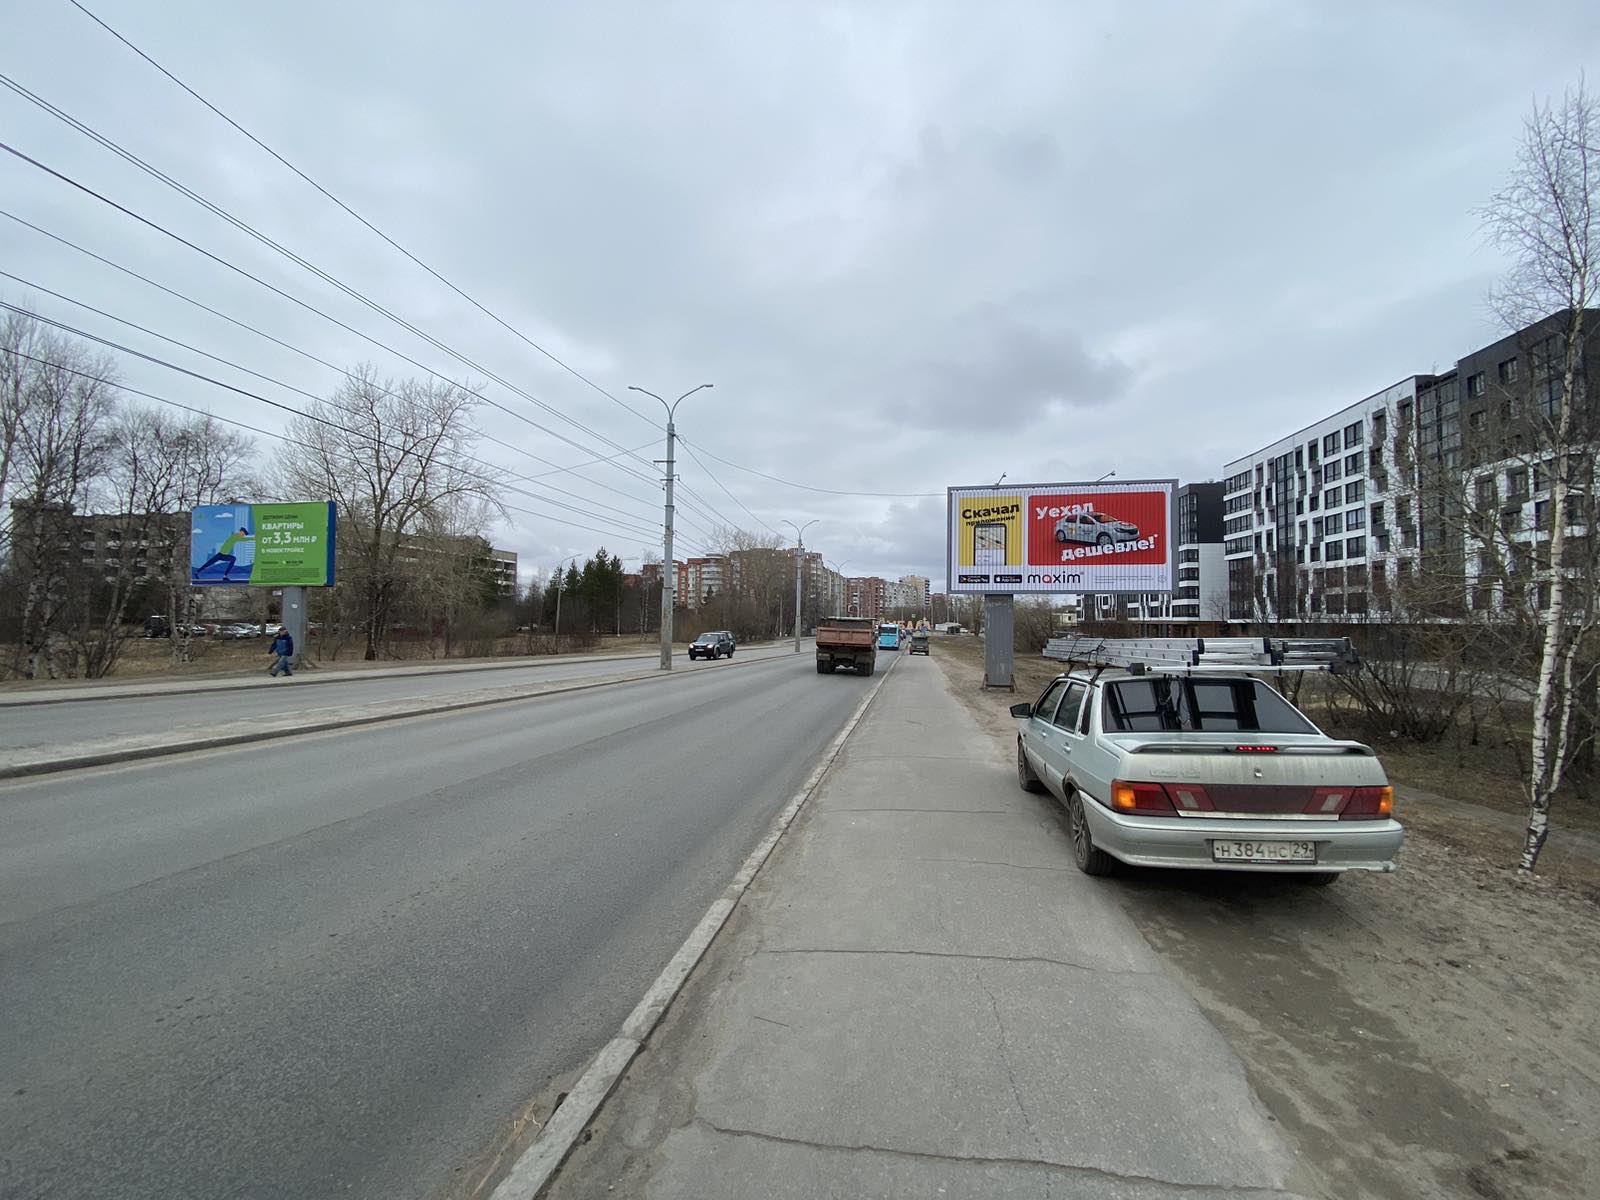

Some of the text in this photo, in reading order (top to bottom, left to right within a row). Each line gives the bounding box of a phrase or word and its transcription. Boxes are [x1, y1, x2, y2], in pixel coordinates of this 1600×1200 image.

[962, 504, 1020, 519] Скачал
[1035, 502, 1094, 520] Уехал
[262, 522, 304, 530] КВАРТИРЫ
[966, 515, 1016, 526] приложение
[273, 532, 292, 545] 3,3
[1028, 571, 1081, 584] maxim
[1293, 842, 1309, 855] 29
